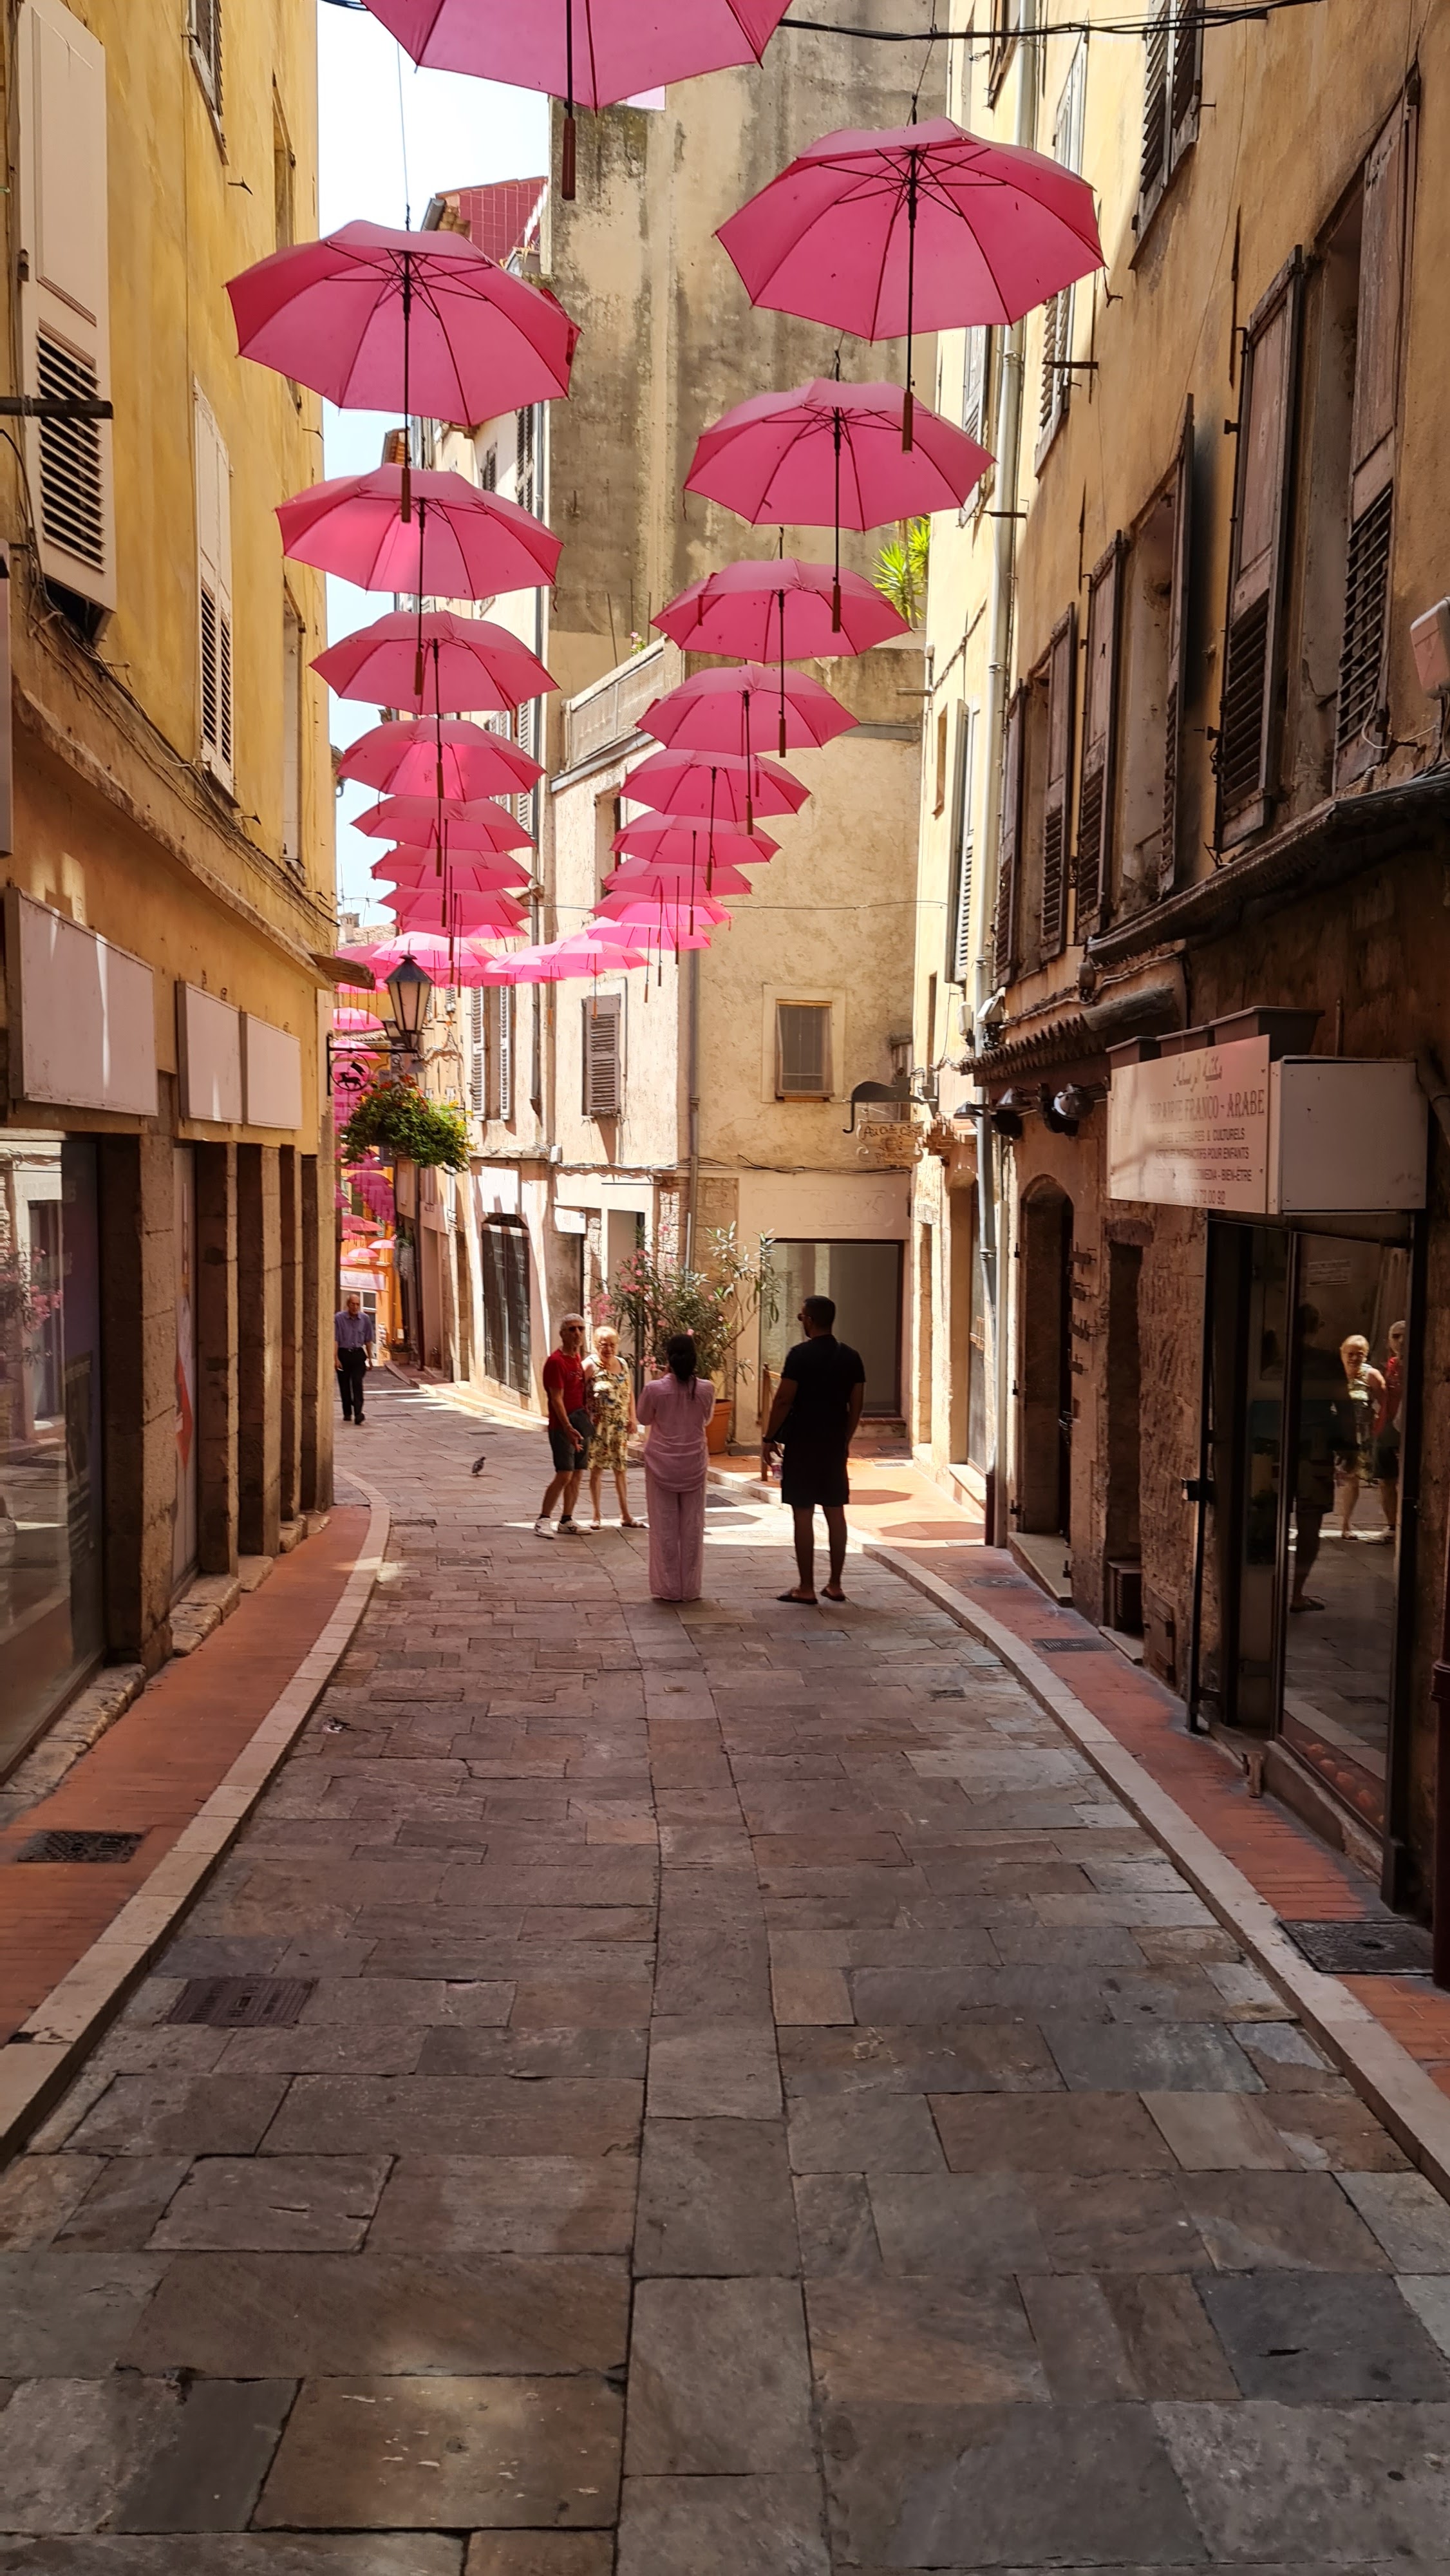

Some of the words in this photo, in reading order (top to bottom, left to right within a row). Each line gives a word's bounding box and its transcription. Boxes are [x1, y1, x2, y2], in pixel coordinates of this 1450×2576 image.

[1185, 1095, 1219, 1122] FRANCO
[1227, 1089, 1265, 1118] ARABE
[1213, 1127, 1245, 1141] CULTURELS
[1207, 1147, 1223, 1159] POUR
[1223, 1146, 1250, 1159] ENFANTS
